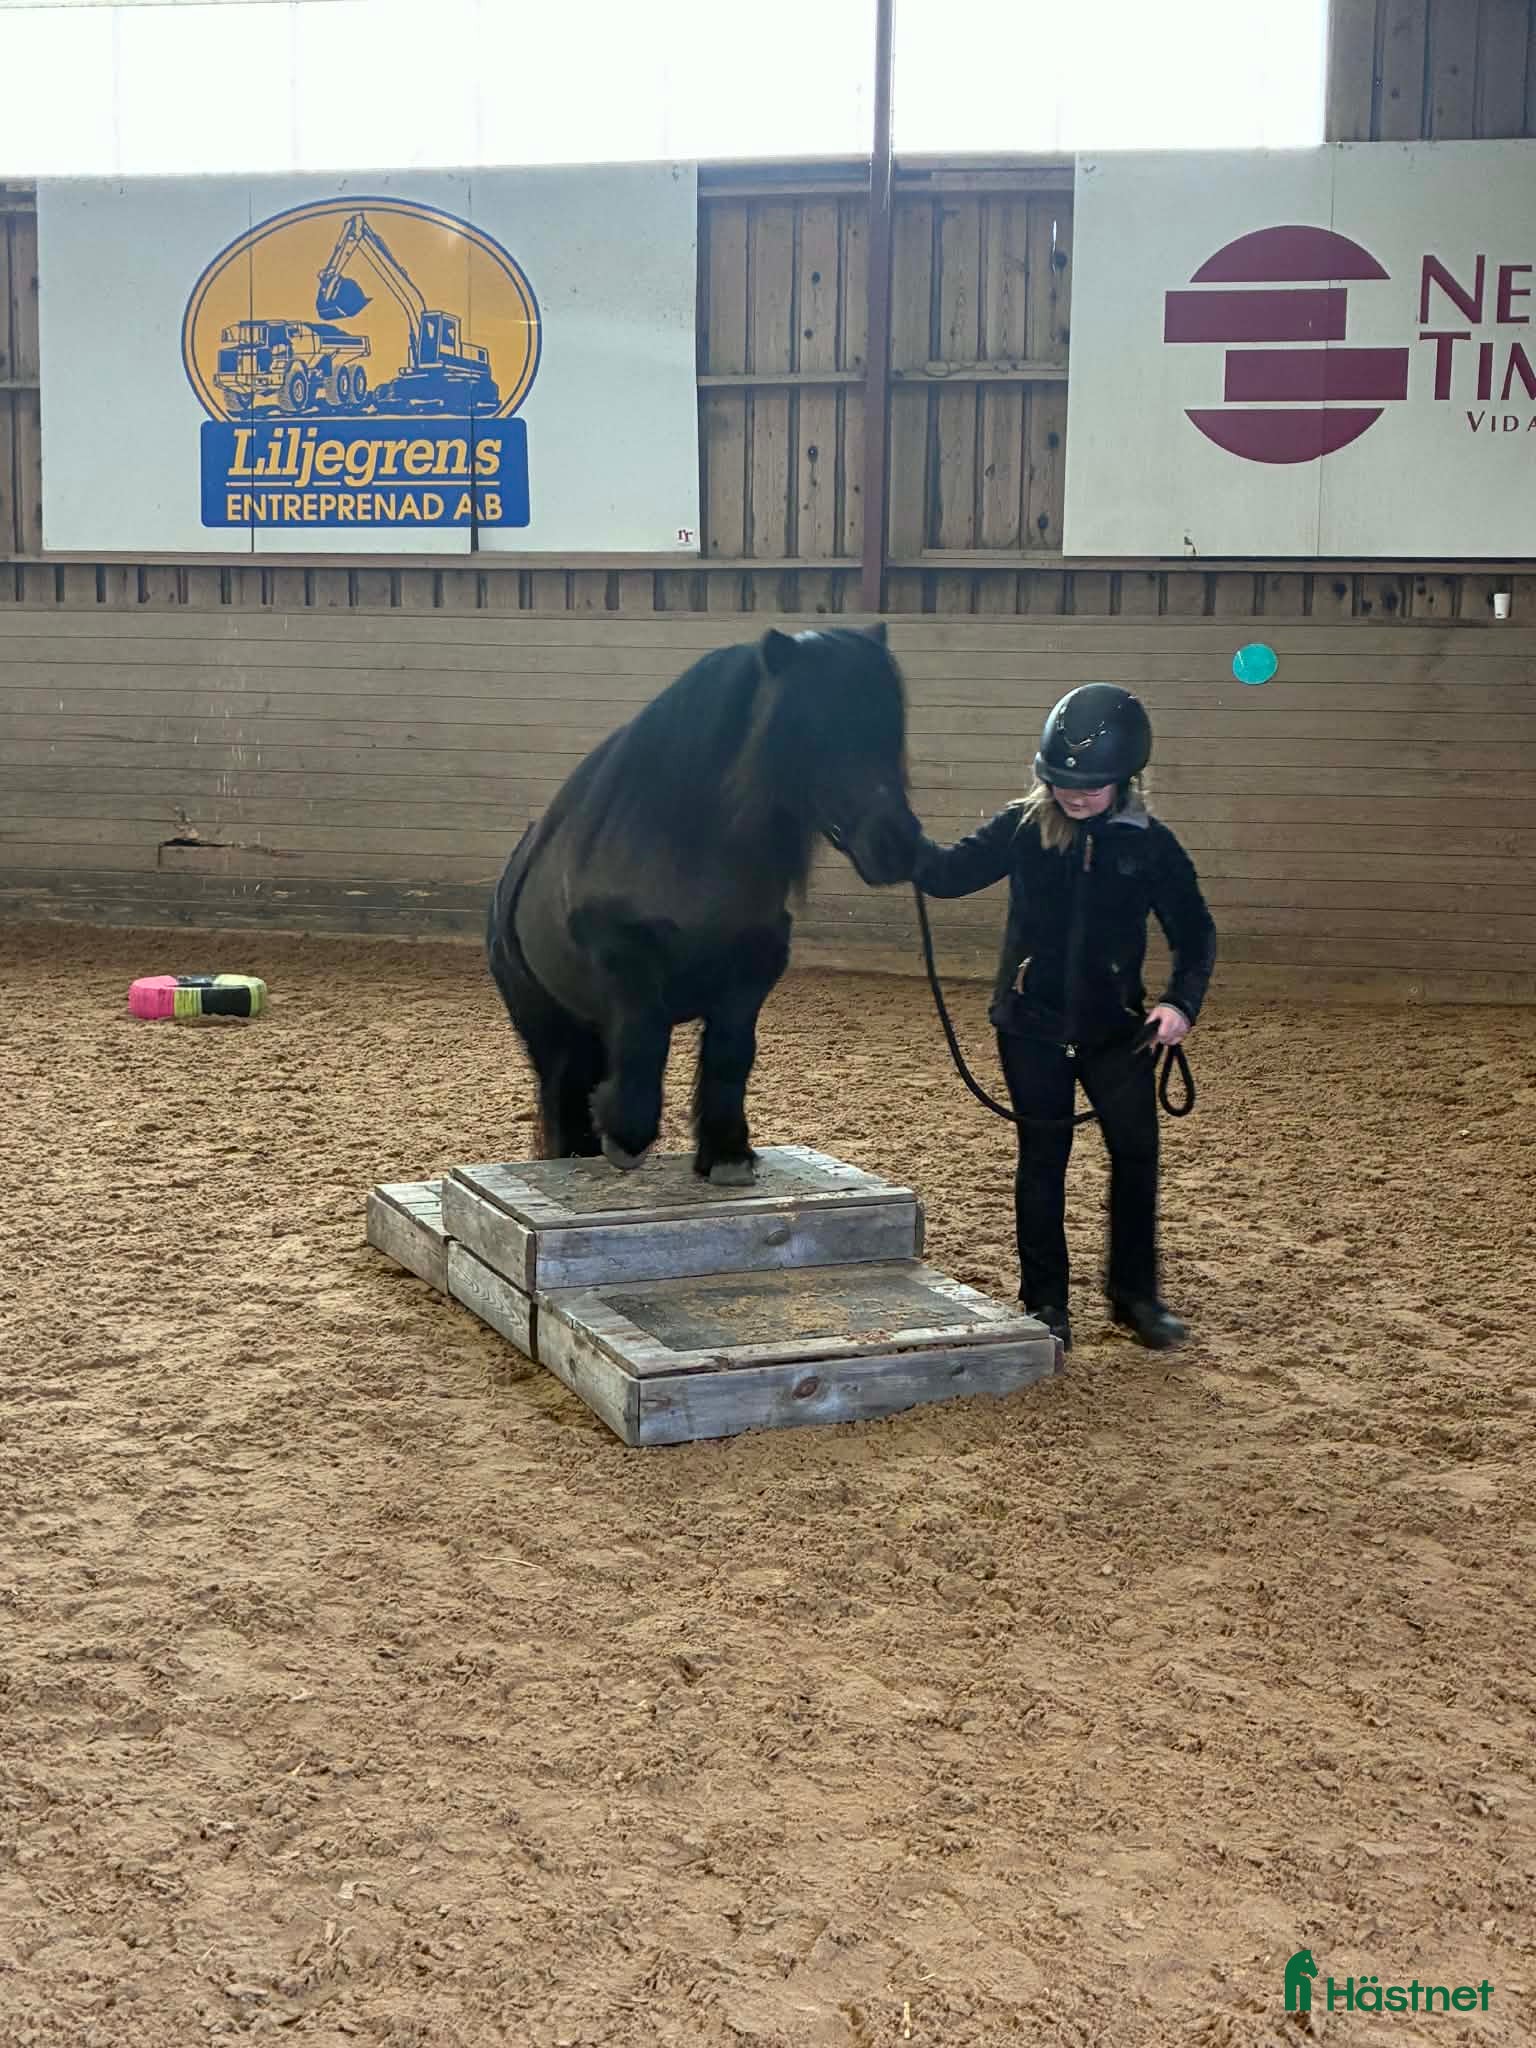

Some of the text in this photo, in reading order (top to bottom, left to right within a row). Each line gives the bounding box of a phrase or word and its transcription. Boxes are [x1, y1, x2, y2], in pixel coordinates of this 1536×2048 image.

[227, 427, 503, 487] Liljegrens
[226, 493, 504, 521] ENTREPRENAD AB
